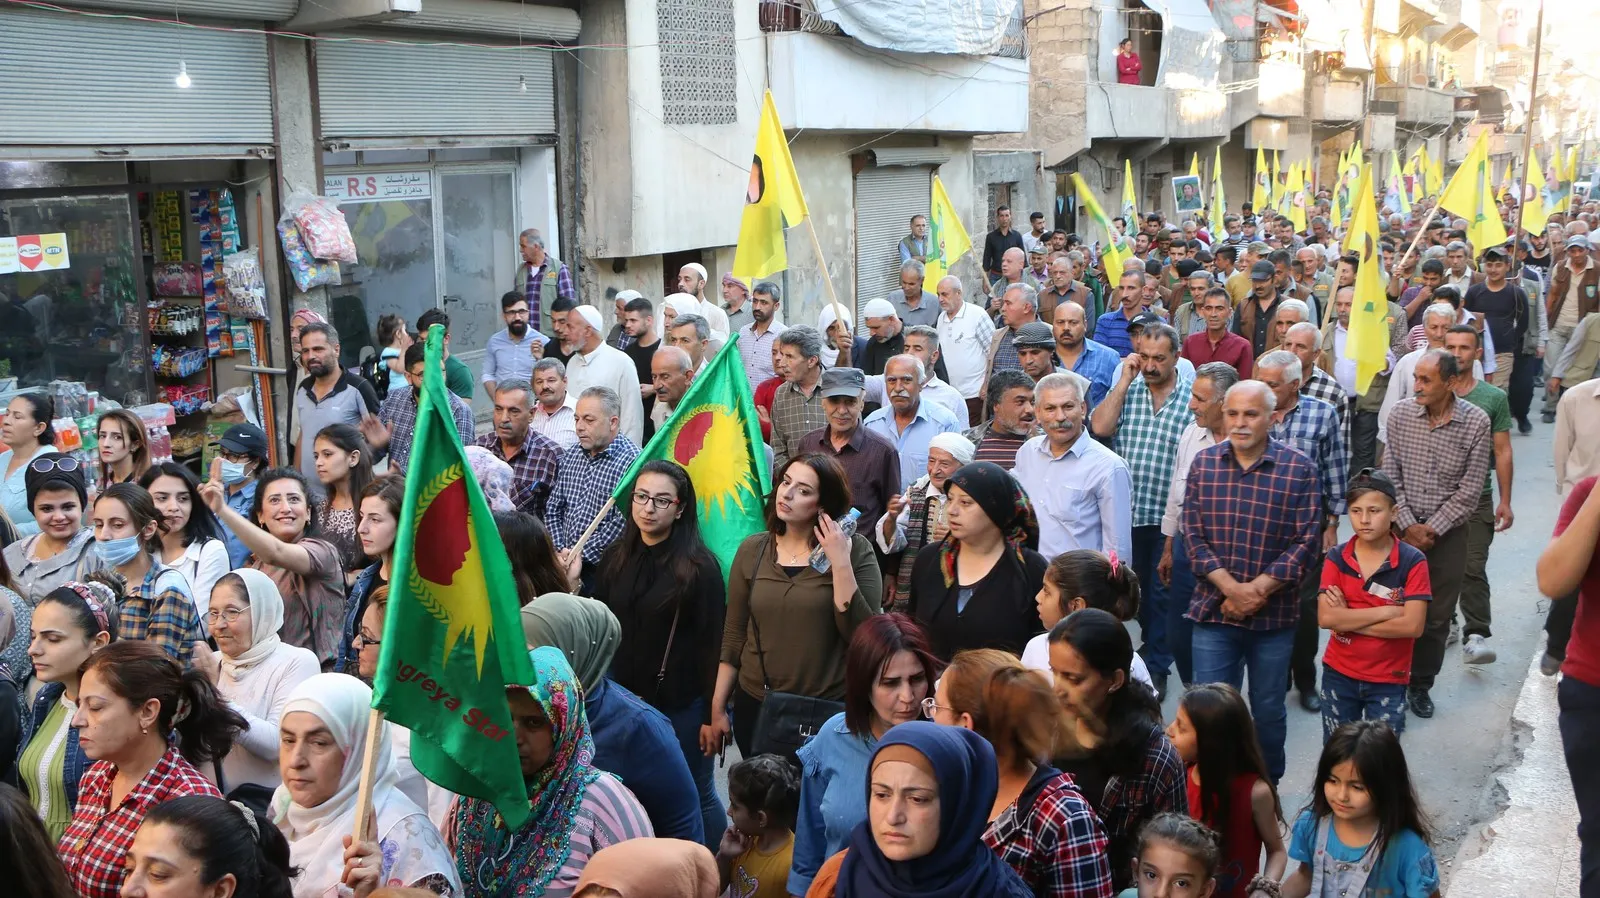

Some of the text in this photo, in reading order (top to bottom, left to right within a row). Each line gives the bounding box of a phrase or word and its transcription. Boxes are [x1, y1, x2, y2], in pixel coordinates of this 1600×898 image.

[348, 177, 377, 196] R.S
[385, 173, 420, 184] مفروشات
[463, 708, 509, 741] Star
